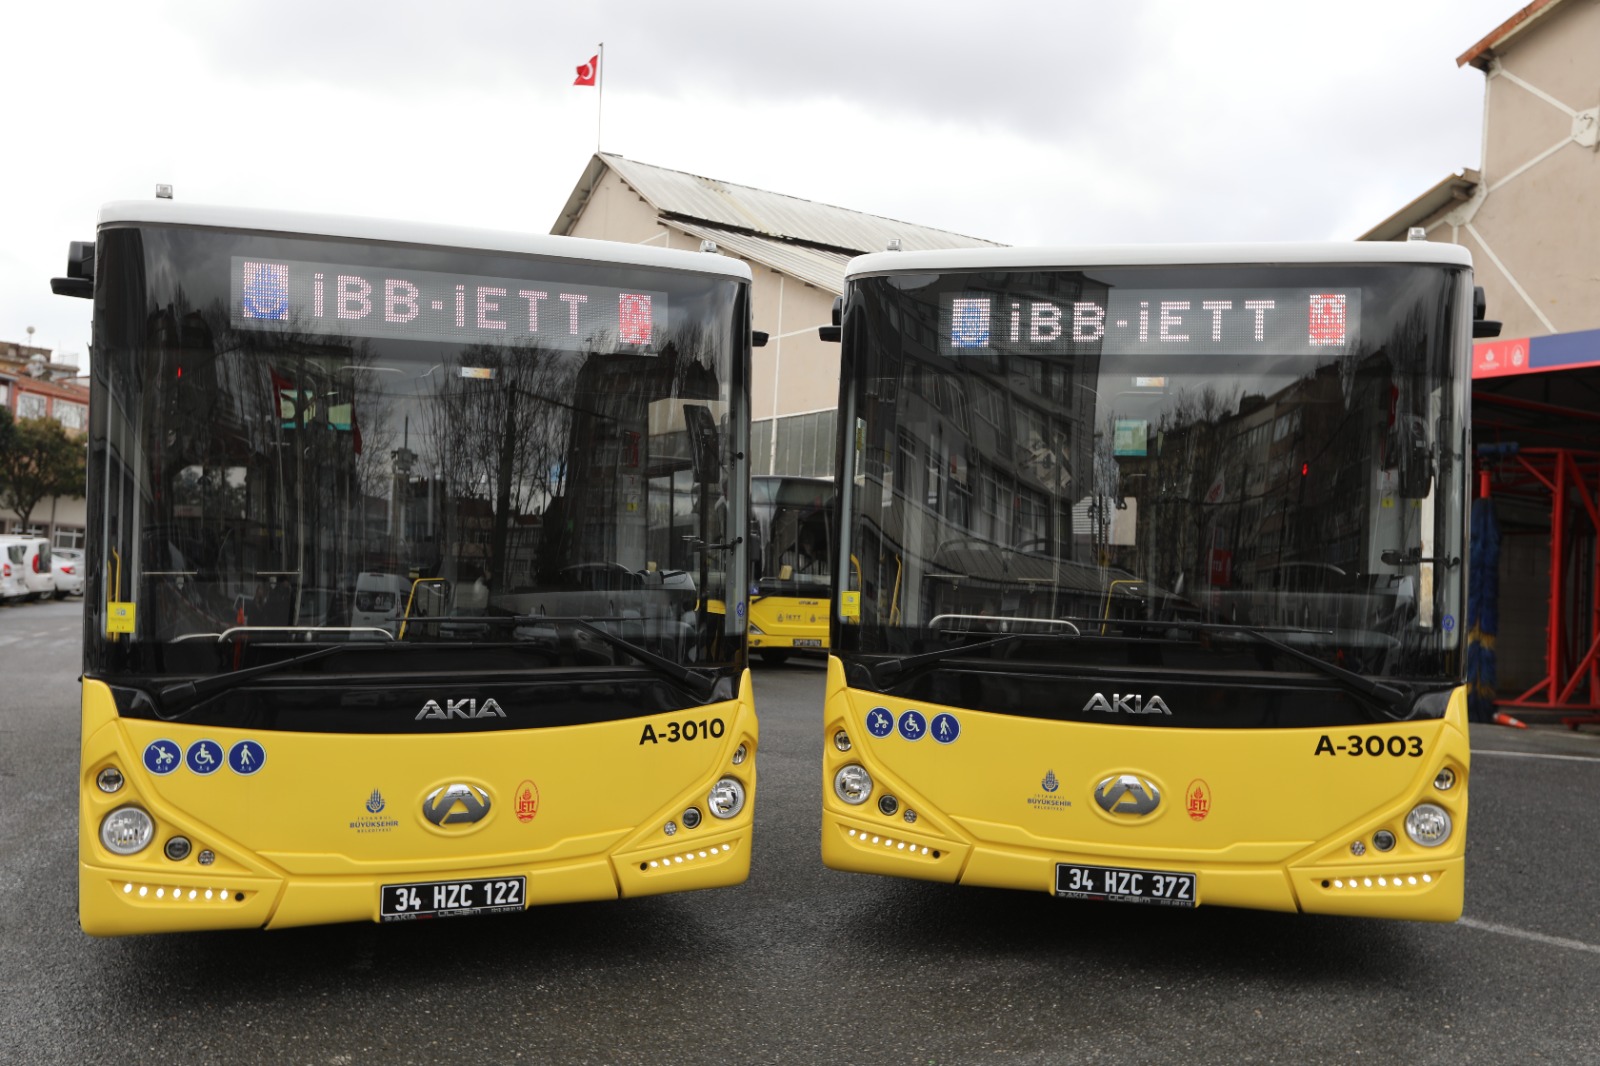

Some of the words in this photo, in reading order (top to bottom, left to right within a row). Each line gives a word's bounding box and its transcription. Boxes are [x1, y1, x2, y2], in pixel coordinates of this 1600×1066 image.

[414, 697, 508, 721] AKIA
[1082, 692, 1173, 716] AKIA
[639, 718, 725, 745] A-3010
[1313, 734, 1424, 758] A-3003
[395, 887, 421, 912] 34
[433, 884, 473, 909] HZC
[484, 880, 520, 905] 122
[1068, 868, 1094, 891] 34
[1104, 871, 1144, 896] HZC
[1151, 875, 1191, 899] 372
